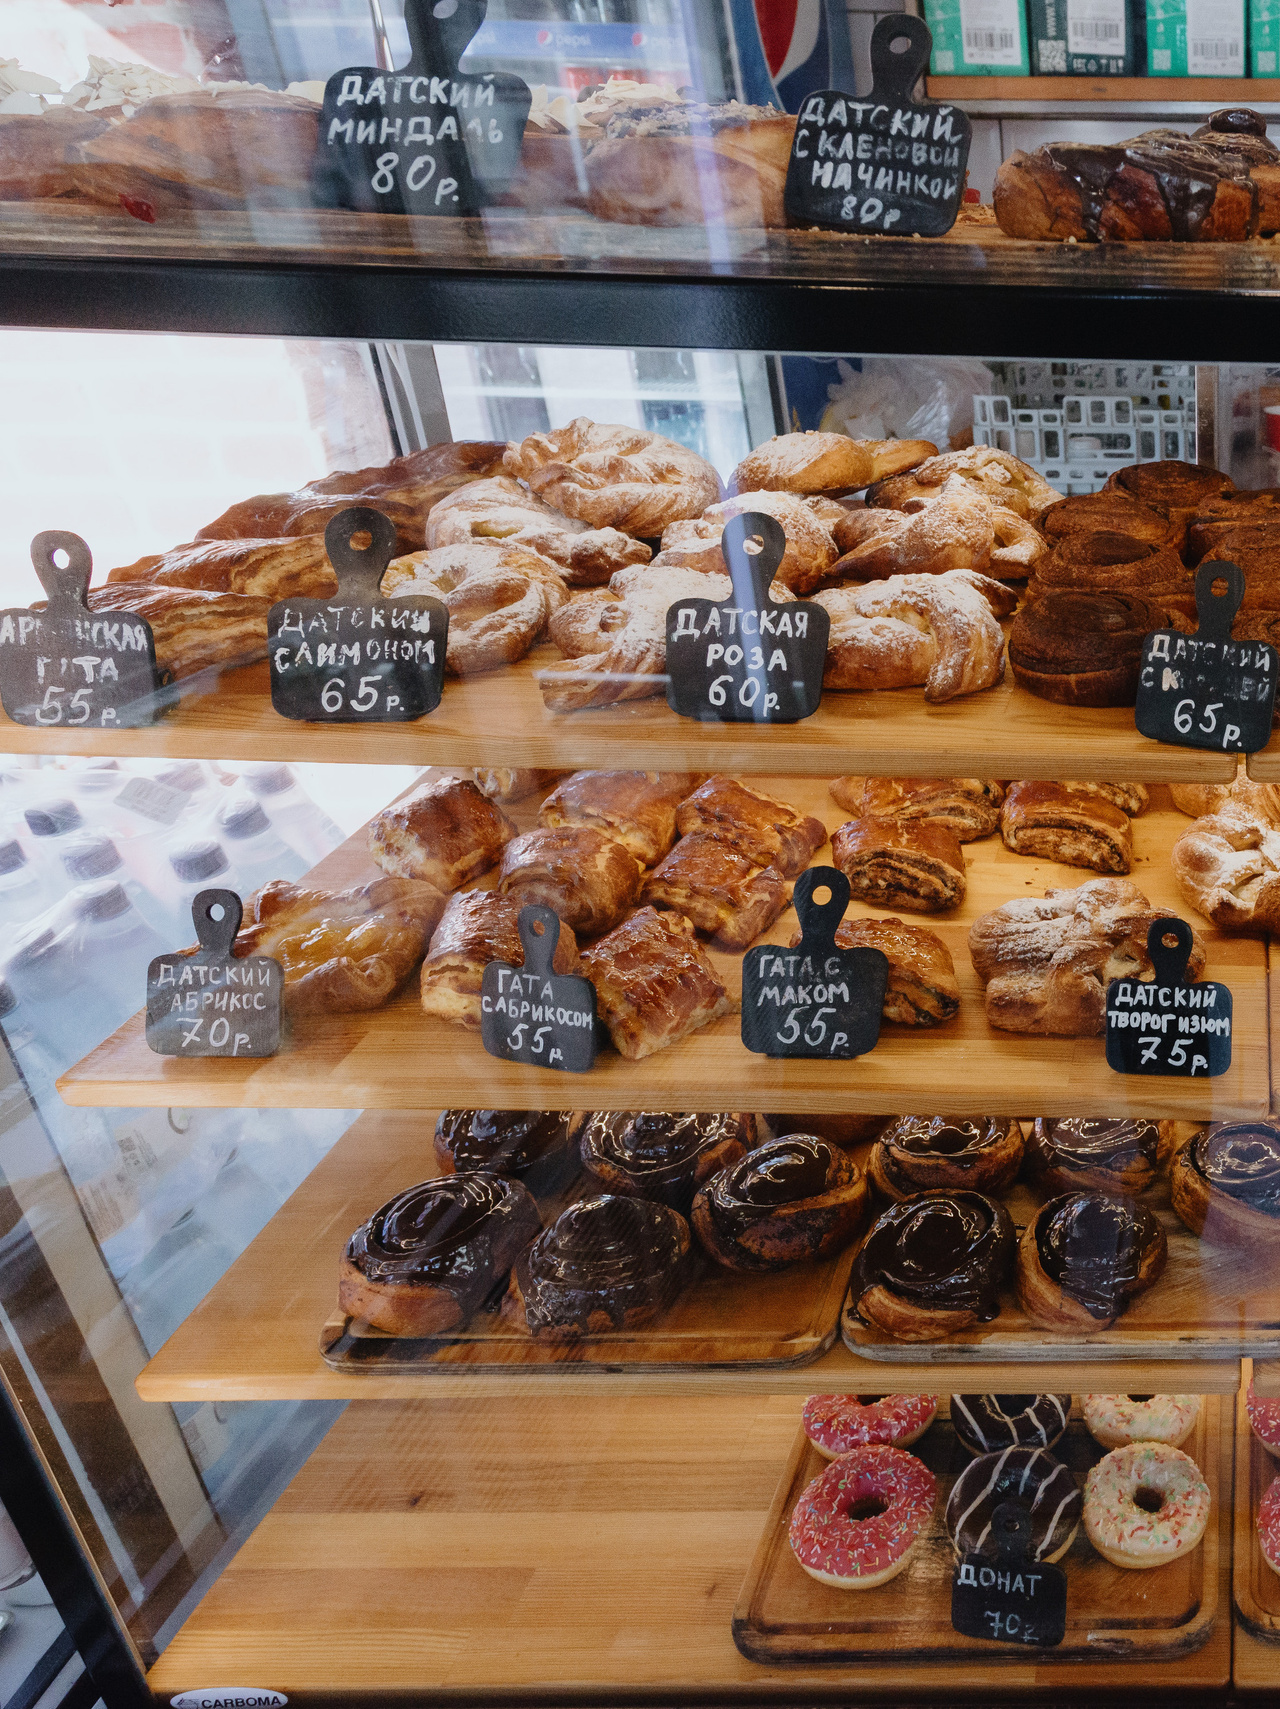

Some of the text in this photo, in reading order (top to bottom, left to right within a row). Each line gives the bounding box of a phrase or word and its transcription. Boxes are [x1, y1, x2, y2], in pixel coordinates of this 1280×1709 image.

[336, 74, 495, 108] ДАТСКИЙ
[800, 97, 955, 141] ДАТСКИЙ
[812, 160, 959, 200] НАЧИНКОЙ
[670, 607, 809, 642] ДАТСКАЯ
[706, 643, 788, 671] РОЗА
[1148, 634, 1271, 671] ДАТСКИЙ
[155, 960, 270, 987] ДАТСКИЙ
[498, 969, 553, 1002] ГАТА
[170, 991, 266, 1012] АБРИКОС
[757, 982, 849, 1006] МАКОМ
[1115, 983, 1217, 1008] ДАТСКИЙ
[1107, 1010, 1230, 1037] ТВОРОГ ИЗЮМ
[957, 1564, 1042, 1596] ДОНАТ
[202, 1696, 281, 1709] CARBOMA
